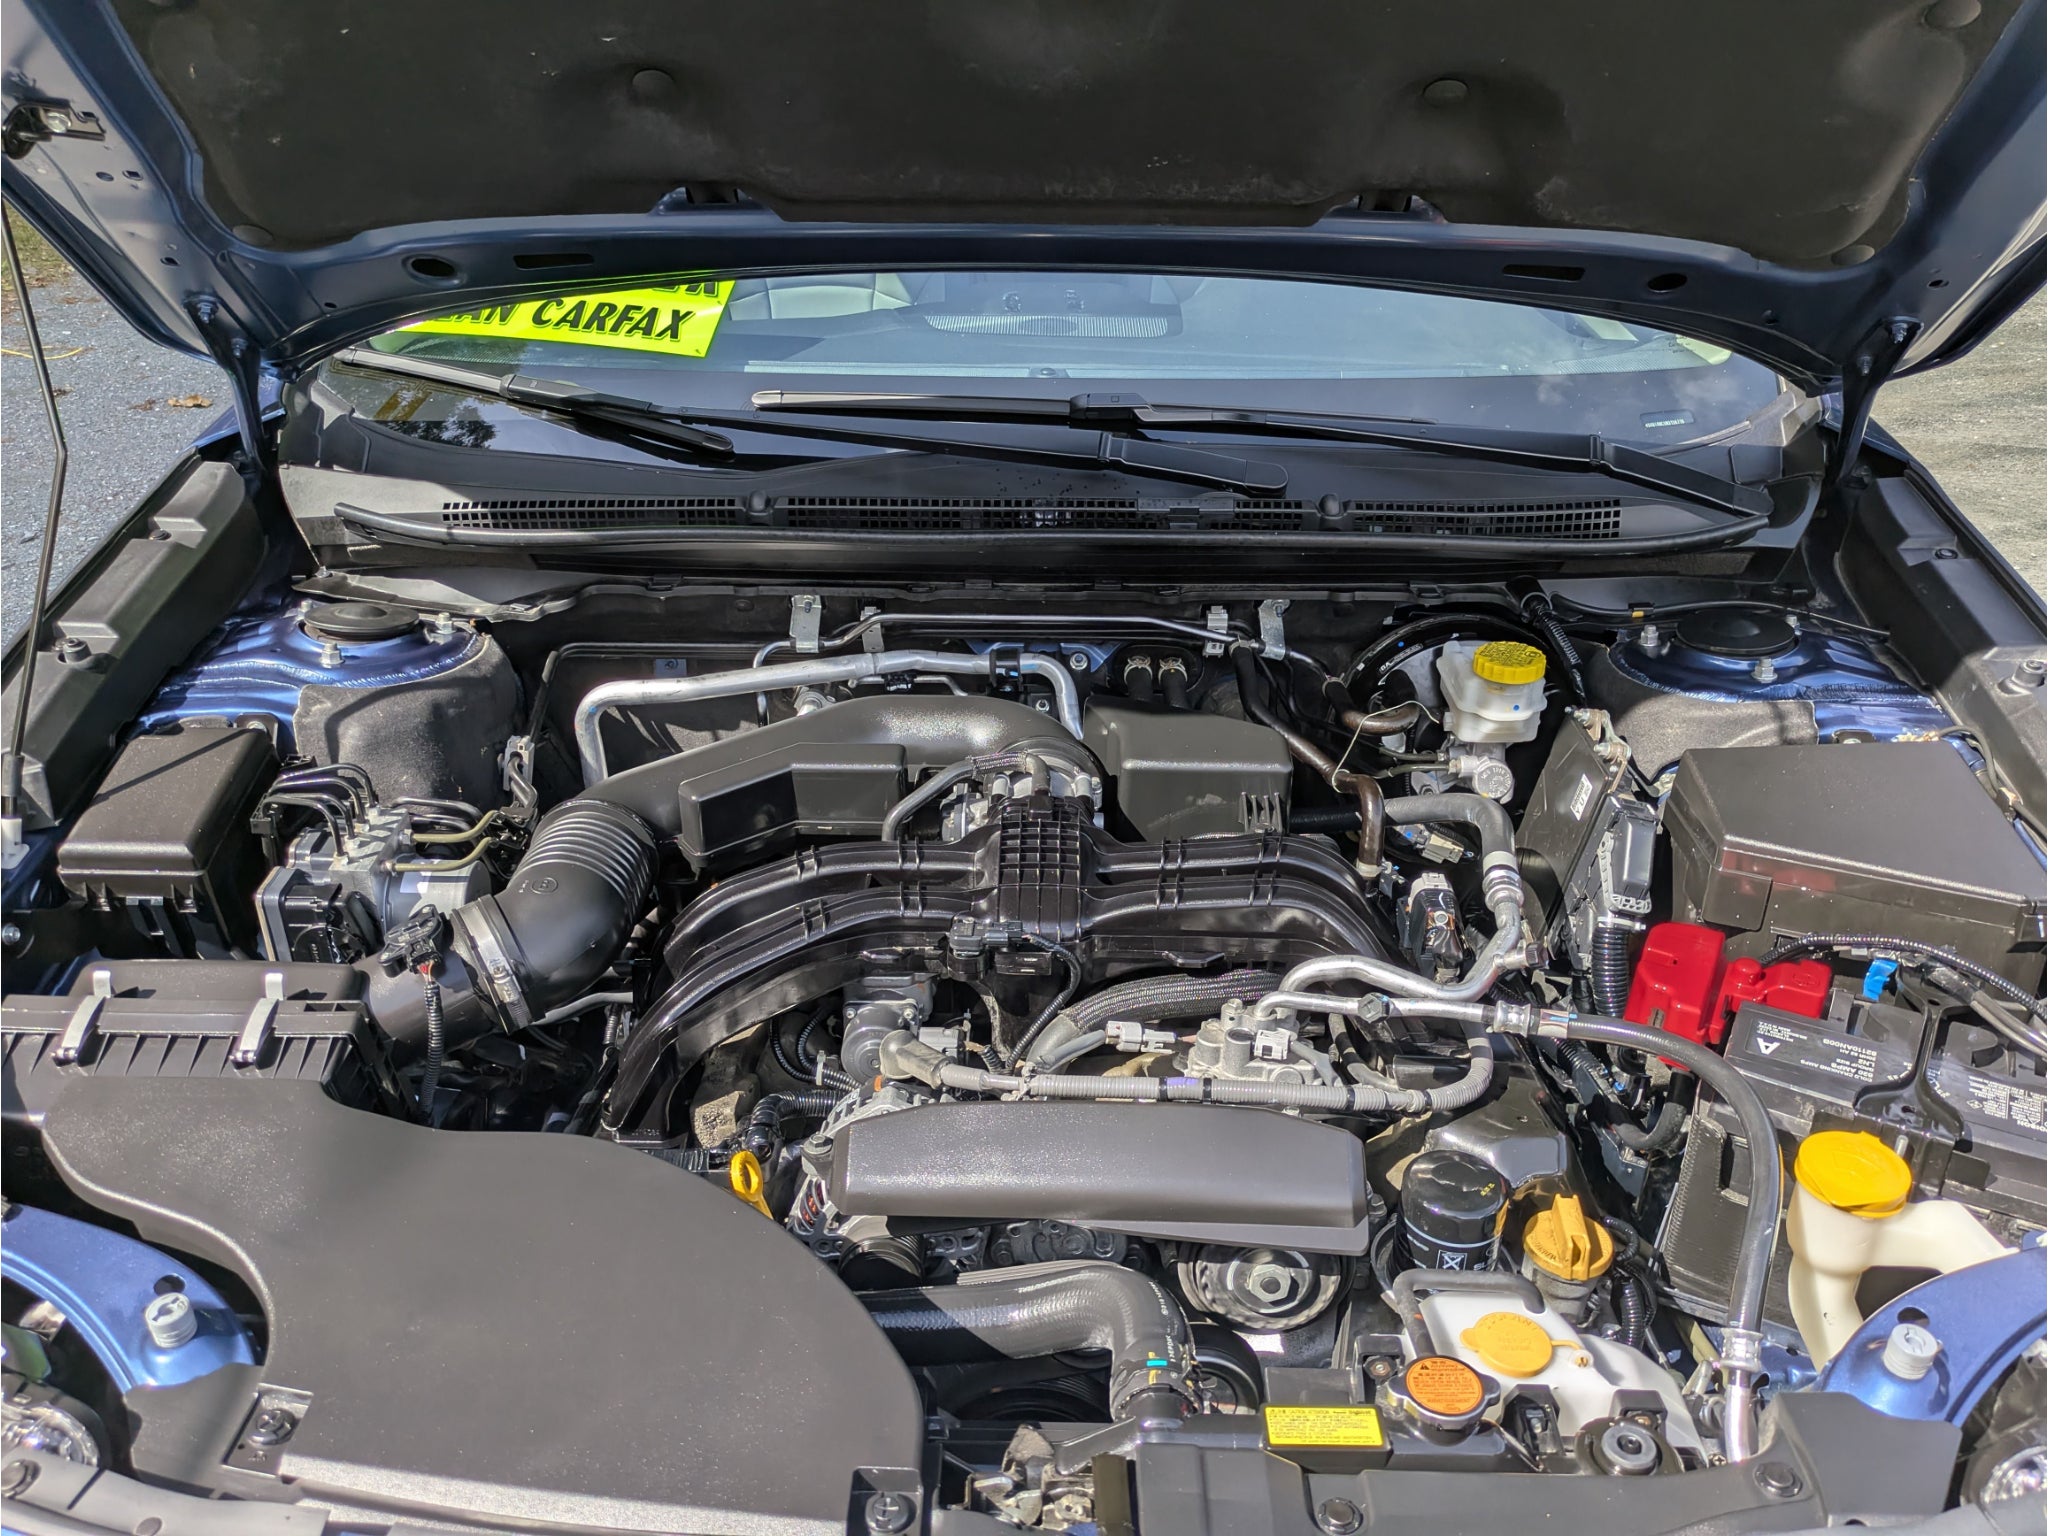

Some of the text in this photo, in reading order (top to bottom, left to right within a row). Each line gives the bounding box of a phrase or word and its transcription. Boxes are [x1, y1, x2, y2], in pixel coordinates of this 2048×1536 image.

[531, 298, 694, 341] CARFAX
[1800, 1059, 1819, 1068] AMPS
[1830, 1062, 1857, 1073] AMPS
[1851, 1062, 1874, 1072] GROUP
[1819, 1064, 1854, 1077] CRANKING
